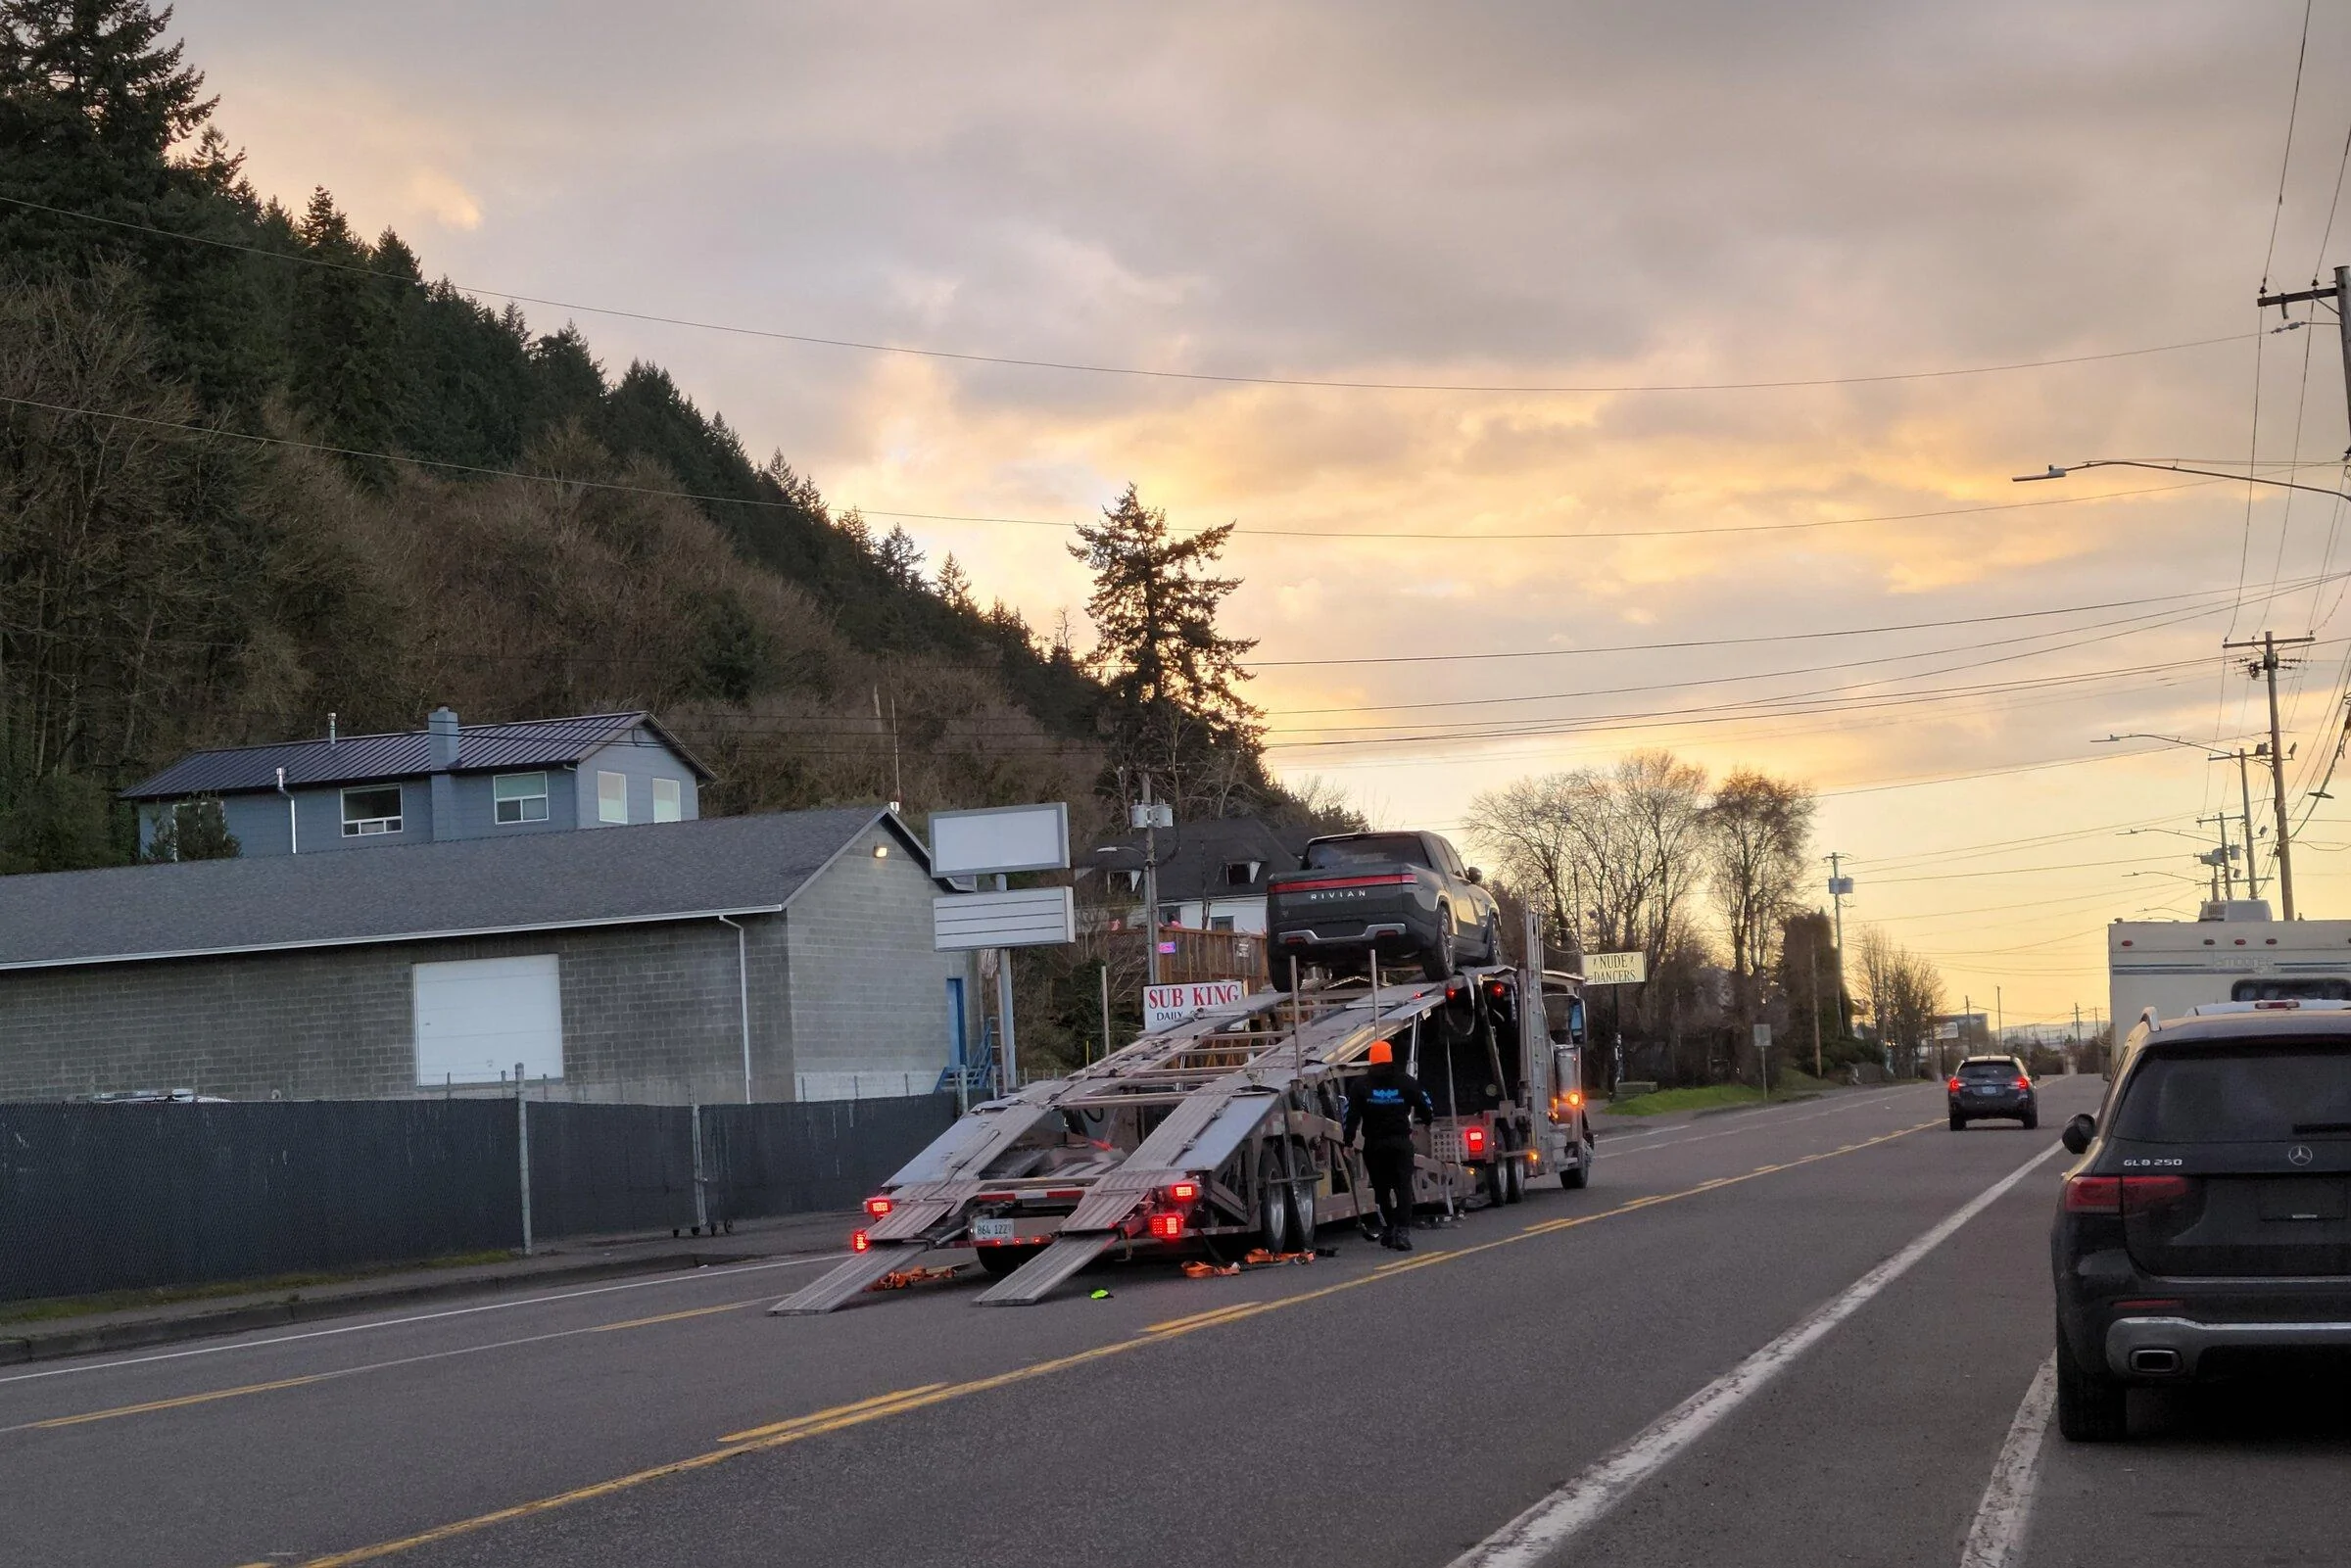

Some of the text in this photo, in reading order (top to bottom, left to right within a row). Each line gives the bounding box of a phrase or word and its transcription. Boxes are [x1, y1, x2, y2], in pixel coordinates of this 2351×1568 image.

[1311, 890, 1366, 901] RIVIAN
[1600, 954, 1628, 969] NUDE
[1594, 970, 1636, 984] DANCERS
[1148, 984, 1239, 1010] SUB KING
[1156, 1010, 1184, 1022] DAILY
